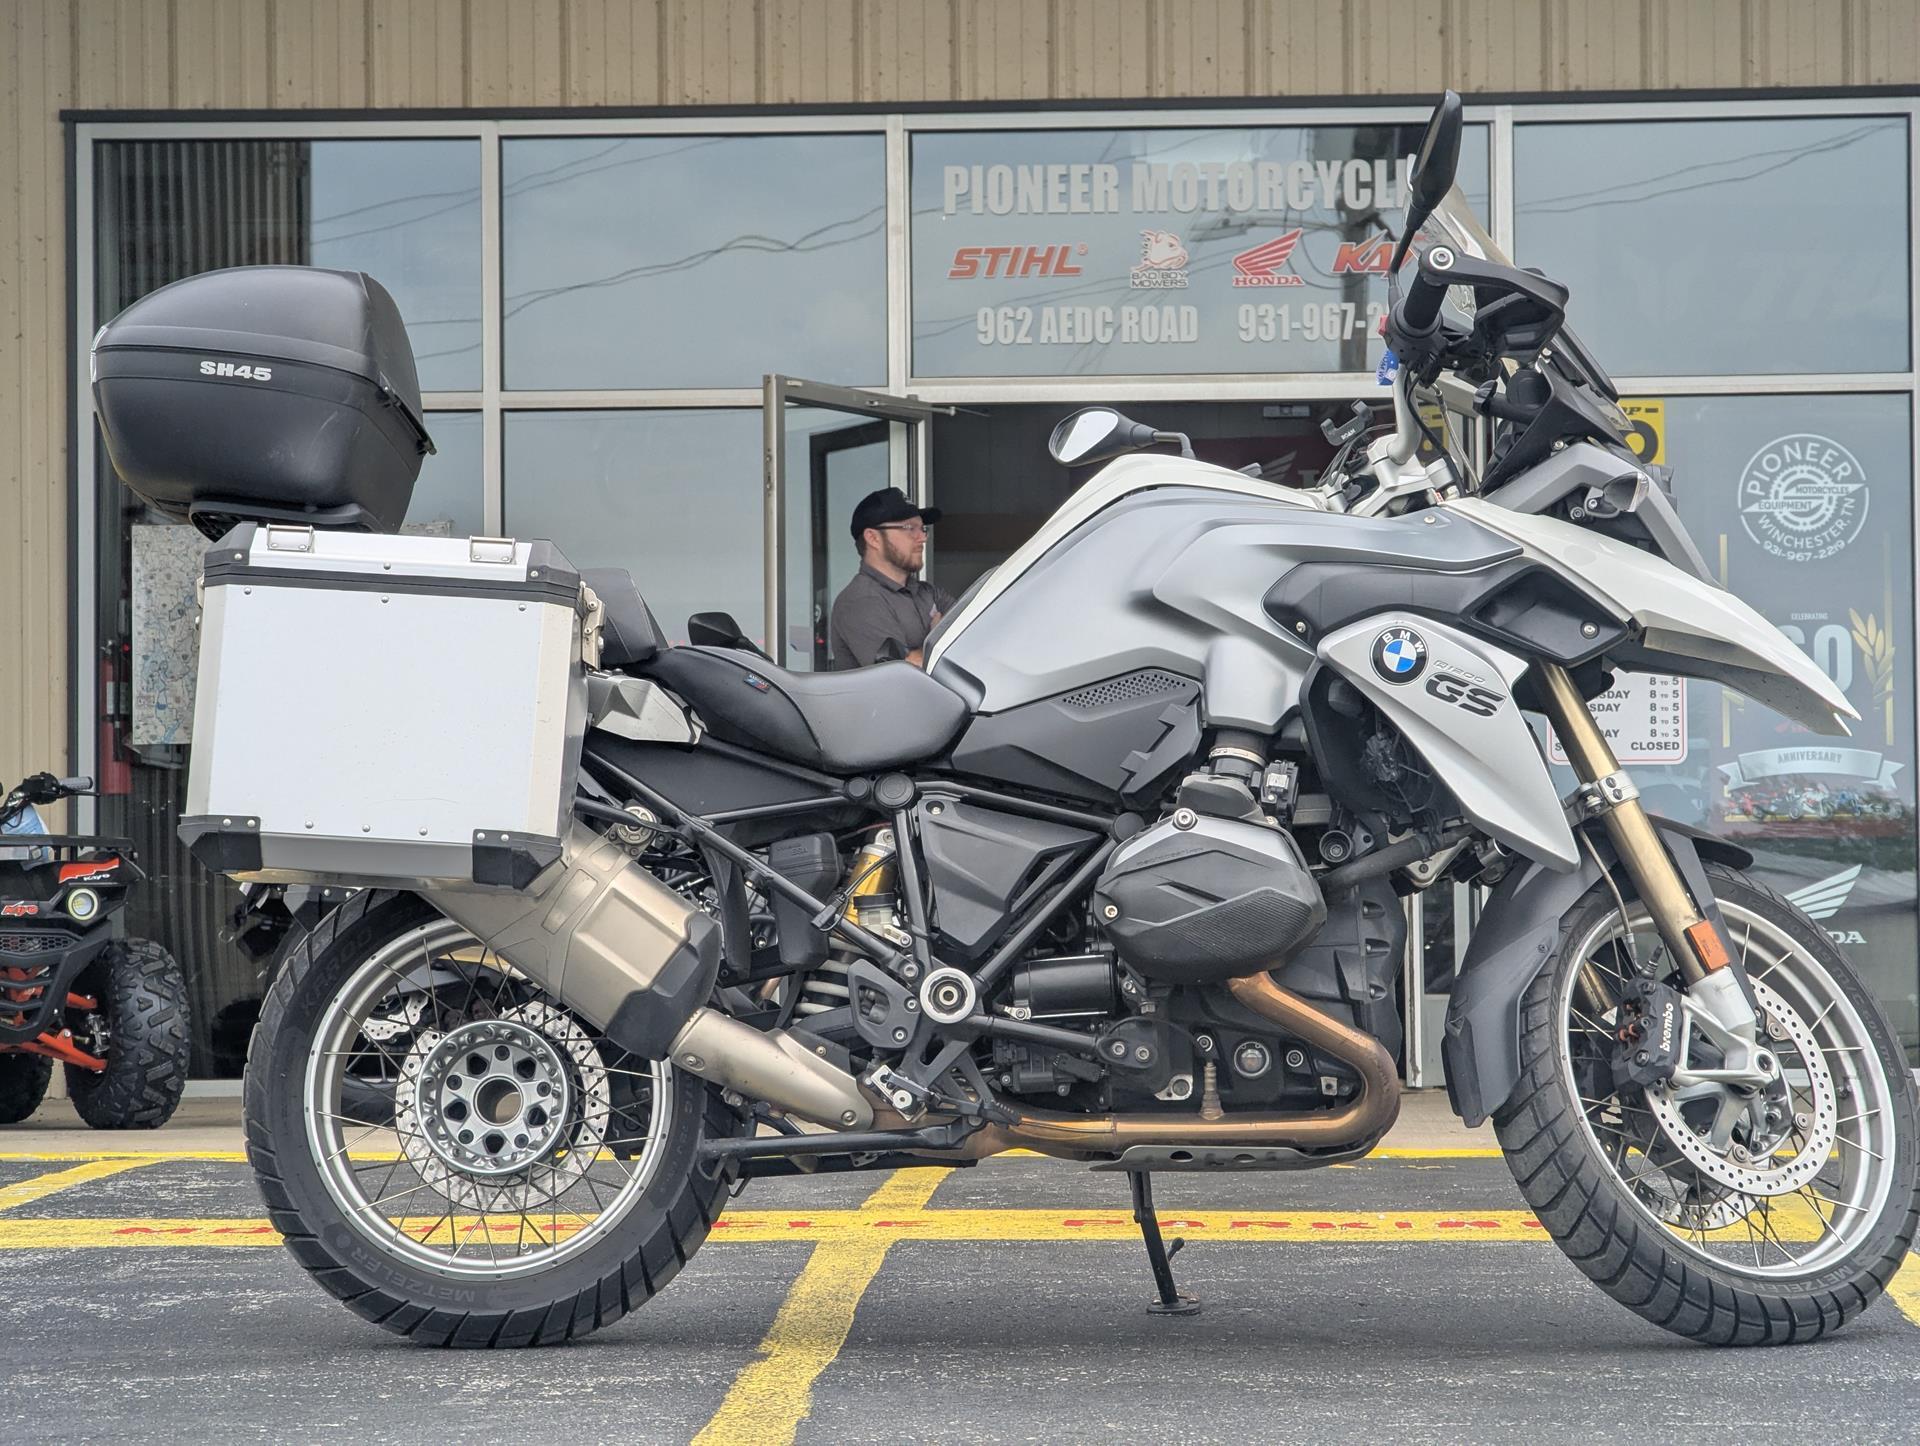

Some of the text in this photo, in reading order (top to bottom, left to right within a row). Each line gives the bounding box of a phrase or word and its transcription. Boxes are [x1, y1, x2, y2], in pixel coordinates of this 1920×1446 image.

[943, 164, 1120, 215] PIONEER
[1131, 271, 1187, 280] BAD BOY
[1234, 276, 1304, 287] HONDA
[1131, 280, 1187, 288] MOWERS
[977, 305, 1199, 345] 962 AEDC ROAD
[200, 361, 272, 381] SH45
[1746, 441, 1852, 496] PIONEER
[1795, 486, 1849, 494] MOTORCYCLES
[1759, 501, 1813, 510] EQUIPMENT
[1840, 497, 1856, 516] TN
[1763, 539, 1846, 562] 931-967-2219
[1790, 612, 1829, 621] CELEBRATING
[1382, 630, 1425, 654] BMW
[1649, 677, 1657, 686] 8
[1672, 677, 1680, 686] 5
[1425, 673, 1506, 718] GS
[1649, 690, 1657, 698] 8
[1672, 690, 1680, 698] 5
[1649, 703, 1657, 711] 8
[1672, 703, 1680, 711] 5
[1649, 716, 1657, 724] 8
[1672, 716, 1680, 724] 5
[1649, 729, 1657, 737] 8
[1672, 729, 1680, 737] 3
[1630, 741, 1680, 751] CLOSED
[1777, 750, 1842, 764] ANNIVERSARY
[1660, 1002, 1674, 1052] brembo
[350, 1247, 476, 1303] METZELER
[1752, 1265, 1855, 1293] METZELER
